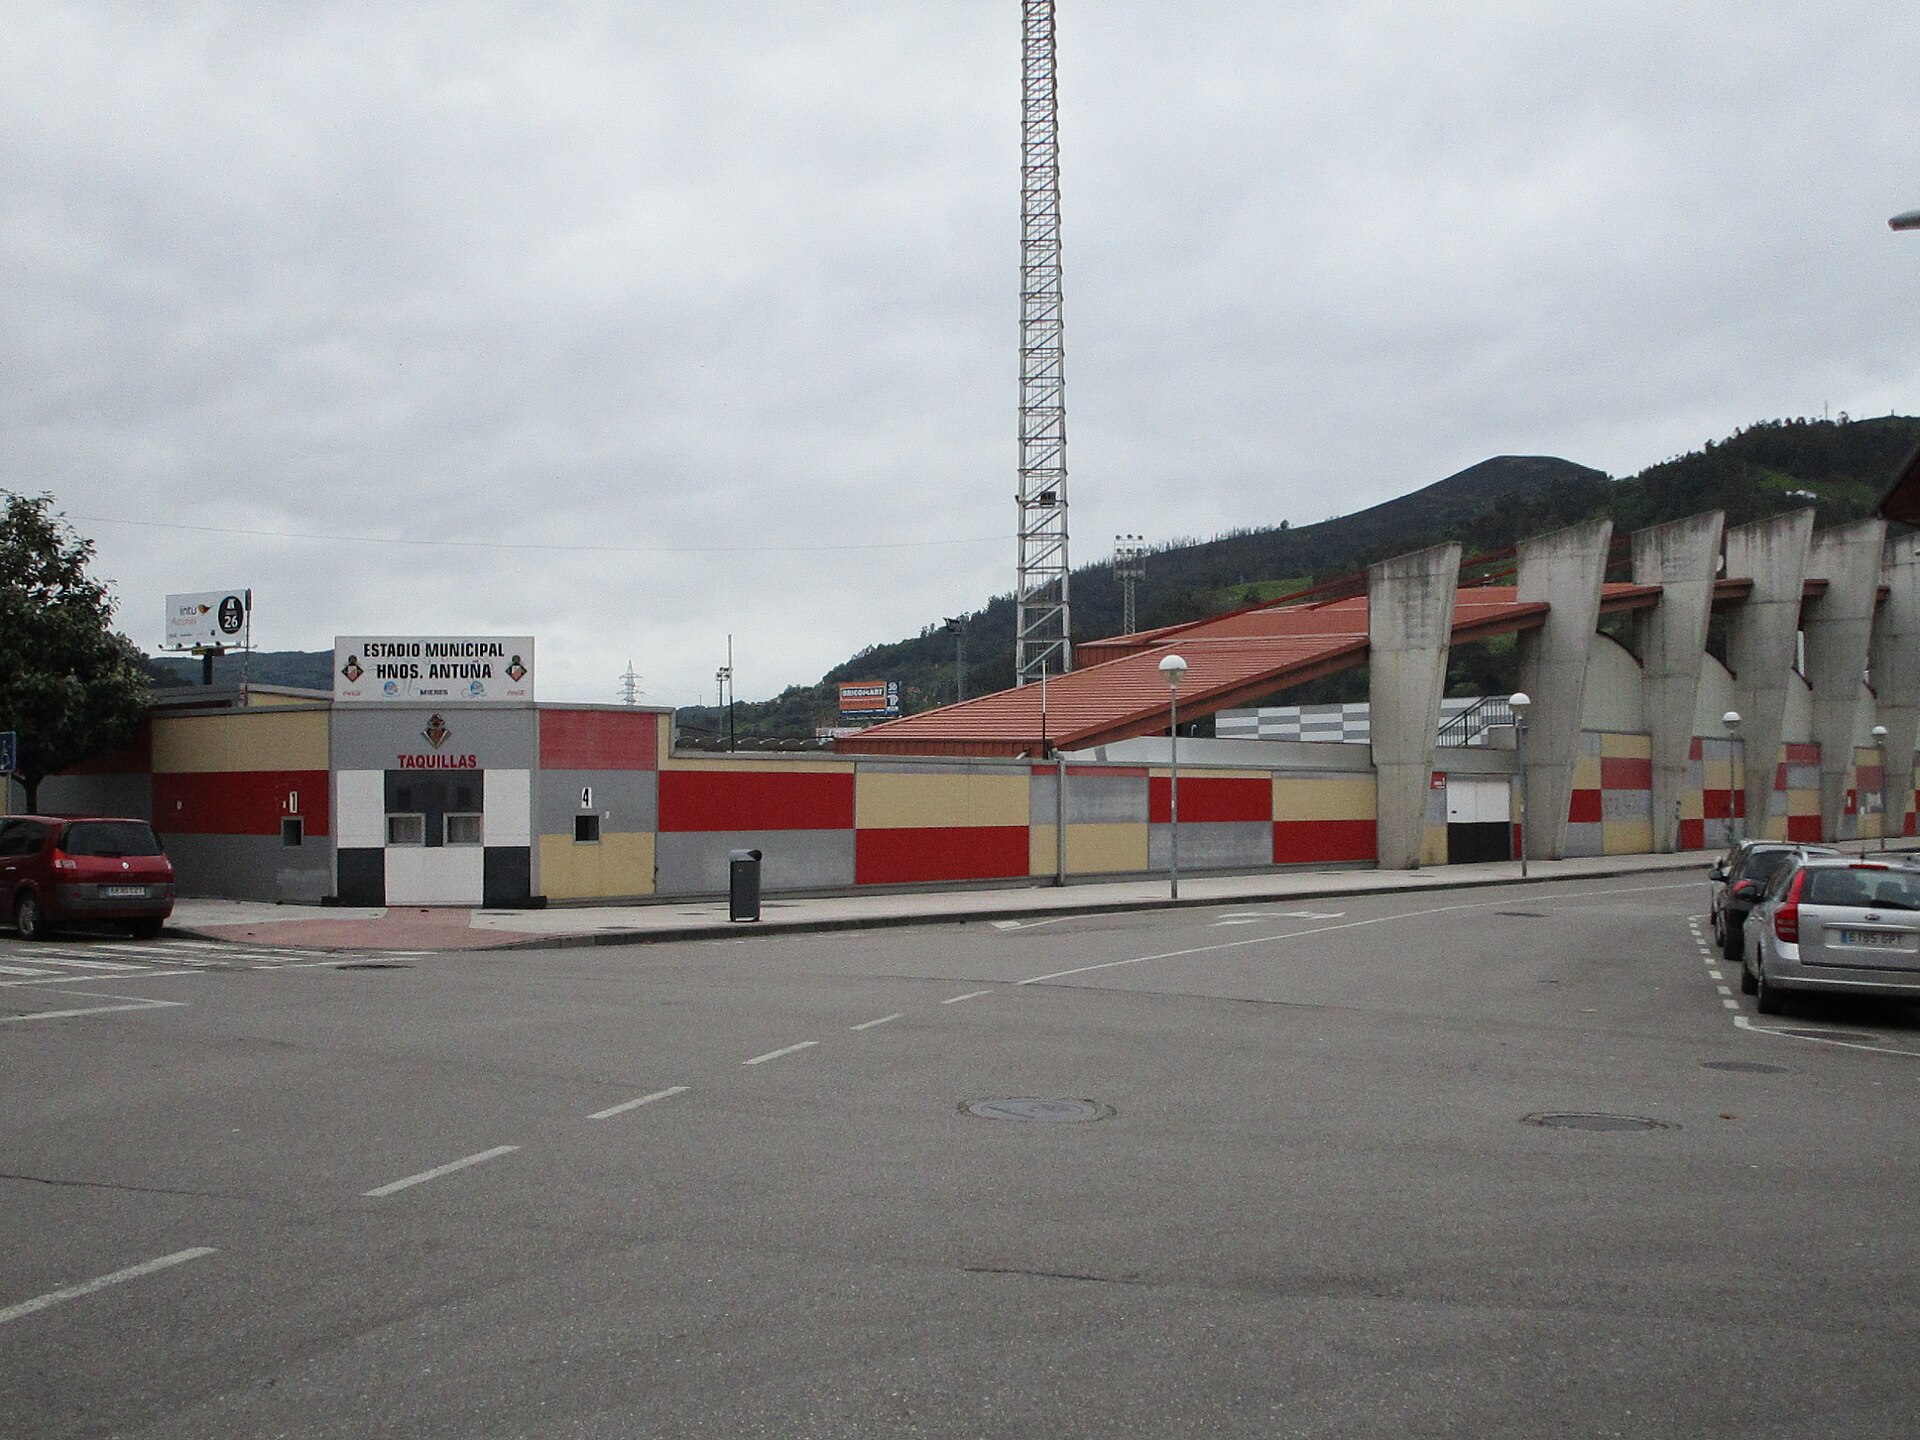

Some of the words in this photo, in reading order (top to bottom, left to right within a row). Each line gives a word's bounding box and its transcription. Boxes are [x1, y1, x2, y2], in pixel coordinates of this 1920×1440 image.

[180, 605, 197, 615] intu
[224, 616, 238, 628] 26
[363, 643, 420, 657] ESTADIO
[425, 643, 505, 657] MUNICIPAL
[376, 664, 423, 679] HNOS.
[428, 660, 492, 679] ANTUÑA
[842, 688, 883, 697] BRICOMART
[397, 754, 477, 768] TAQUILLAS
[582, 788, 589, 807] 4
